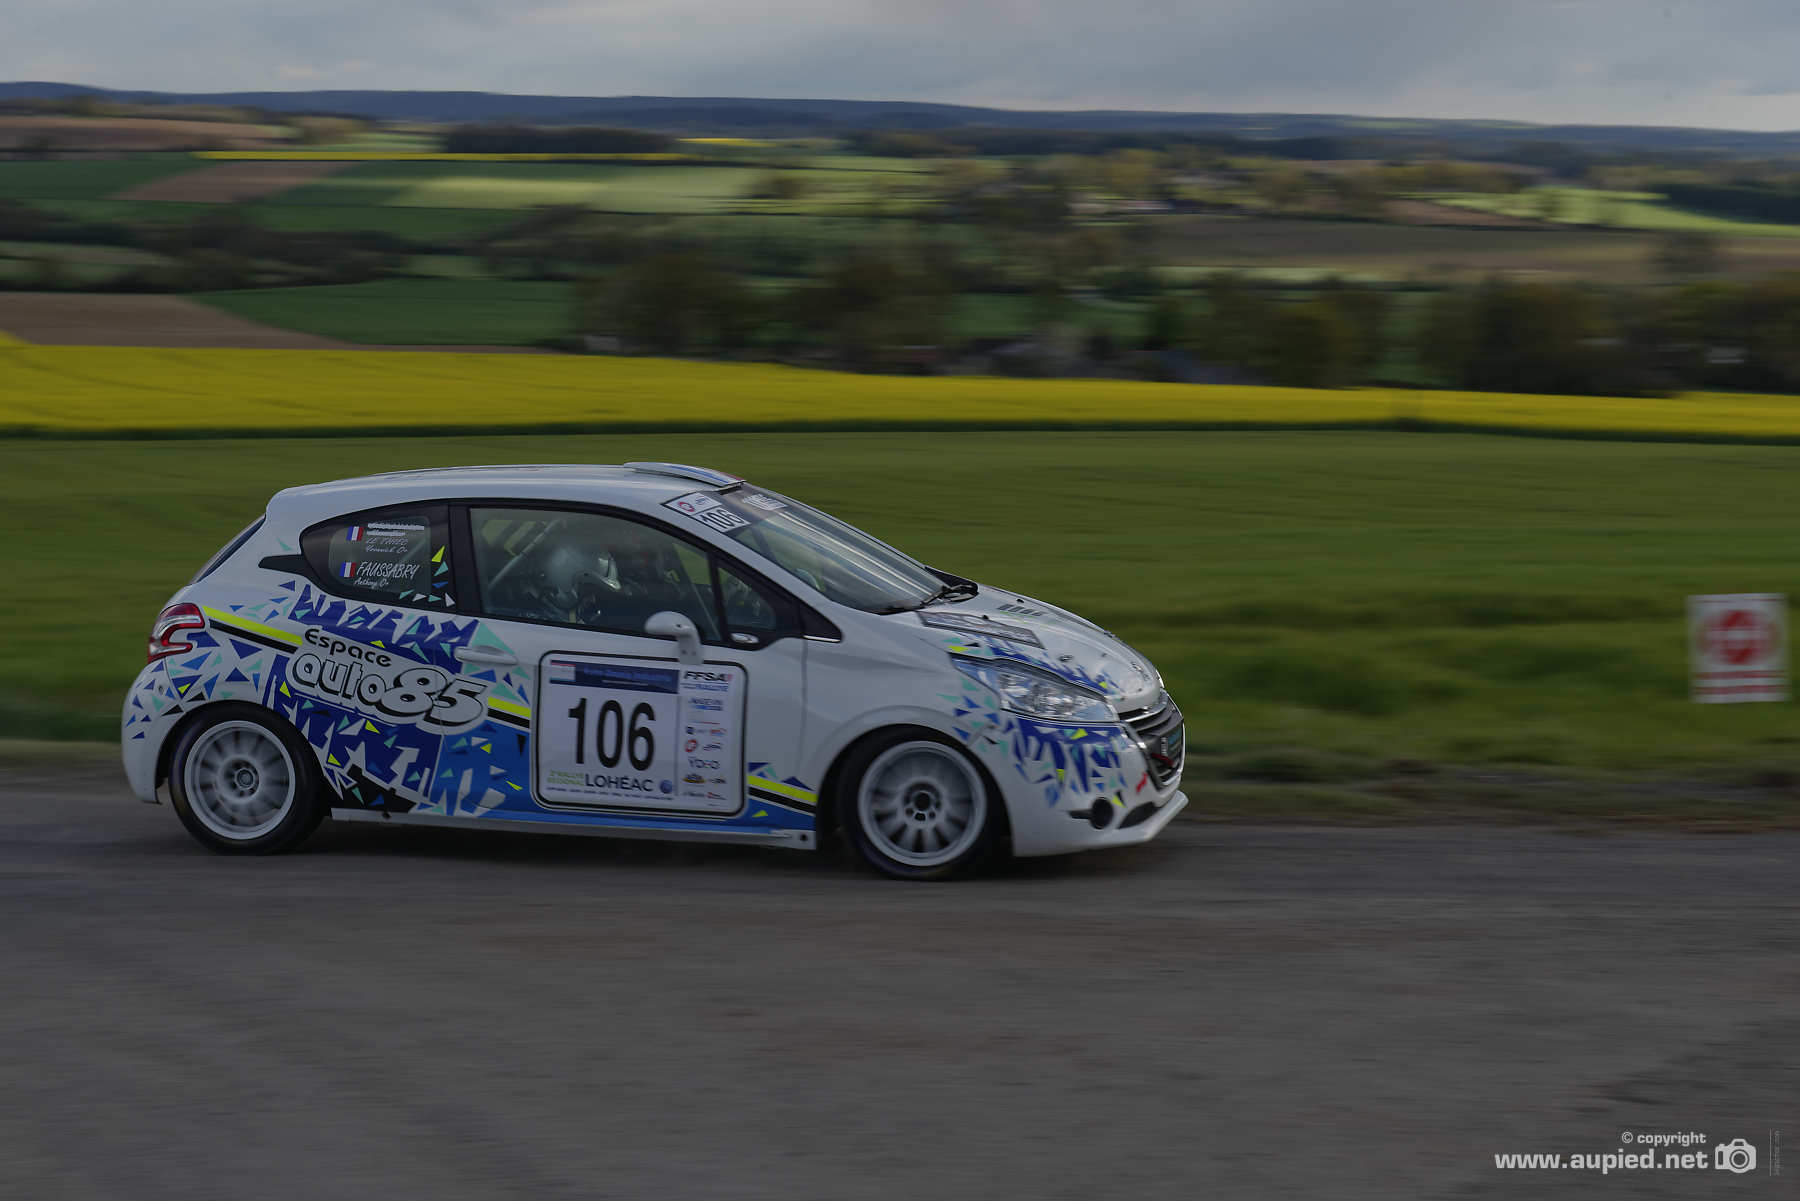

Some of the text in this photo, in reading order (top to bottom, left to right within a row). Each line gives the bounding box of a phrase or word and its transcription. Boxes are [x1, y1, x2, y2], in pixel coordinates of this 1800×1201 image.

[700, 507, 744, 529] 106
[356, 561, 420, 579] FAUSSABRY
[304, 628, 392, 667] Espace
[683, 671, 728, 682] FFSA
[568, 698, 656, 771] 106
[585, 773, 654, 793] LOHÉAC
